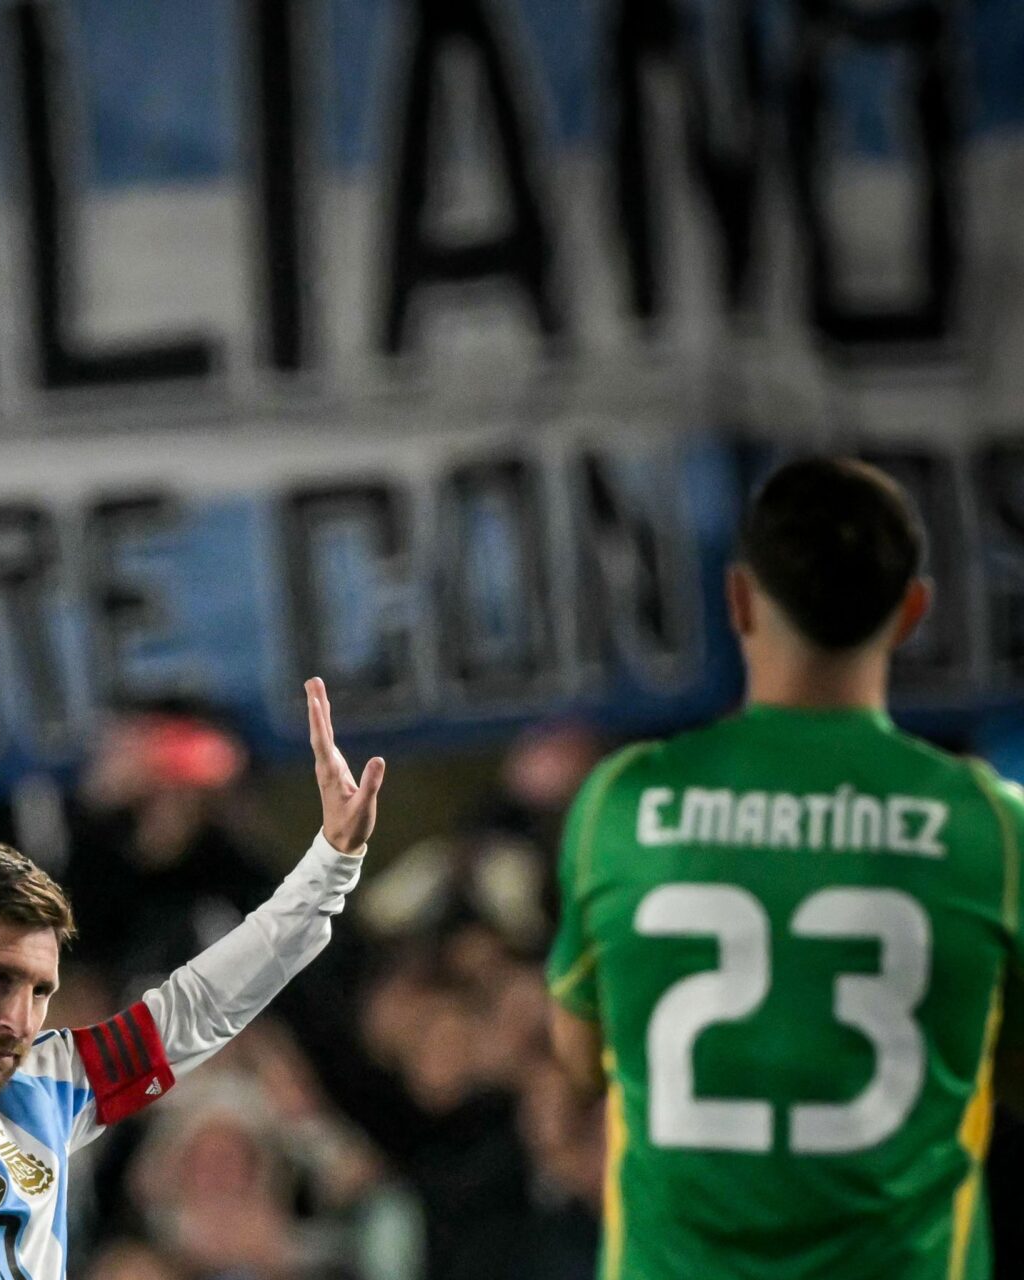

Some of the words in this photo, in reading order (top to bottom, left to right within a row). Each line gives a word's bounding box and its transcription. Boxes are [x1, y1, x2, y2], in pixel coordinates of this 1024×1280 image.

[284, 450, 684, 700] CON
[636, 782, 949, 859] E.MARTÍNEZ
[633, 882, 932, 1154] 23
